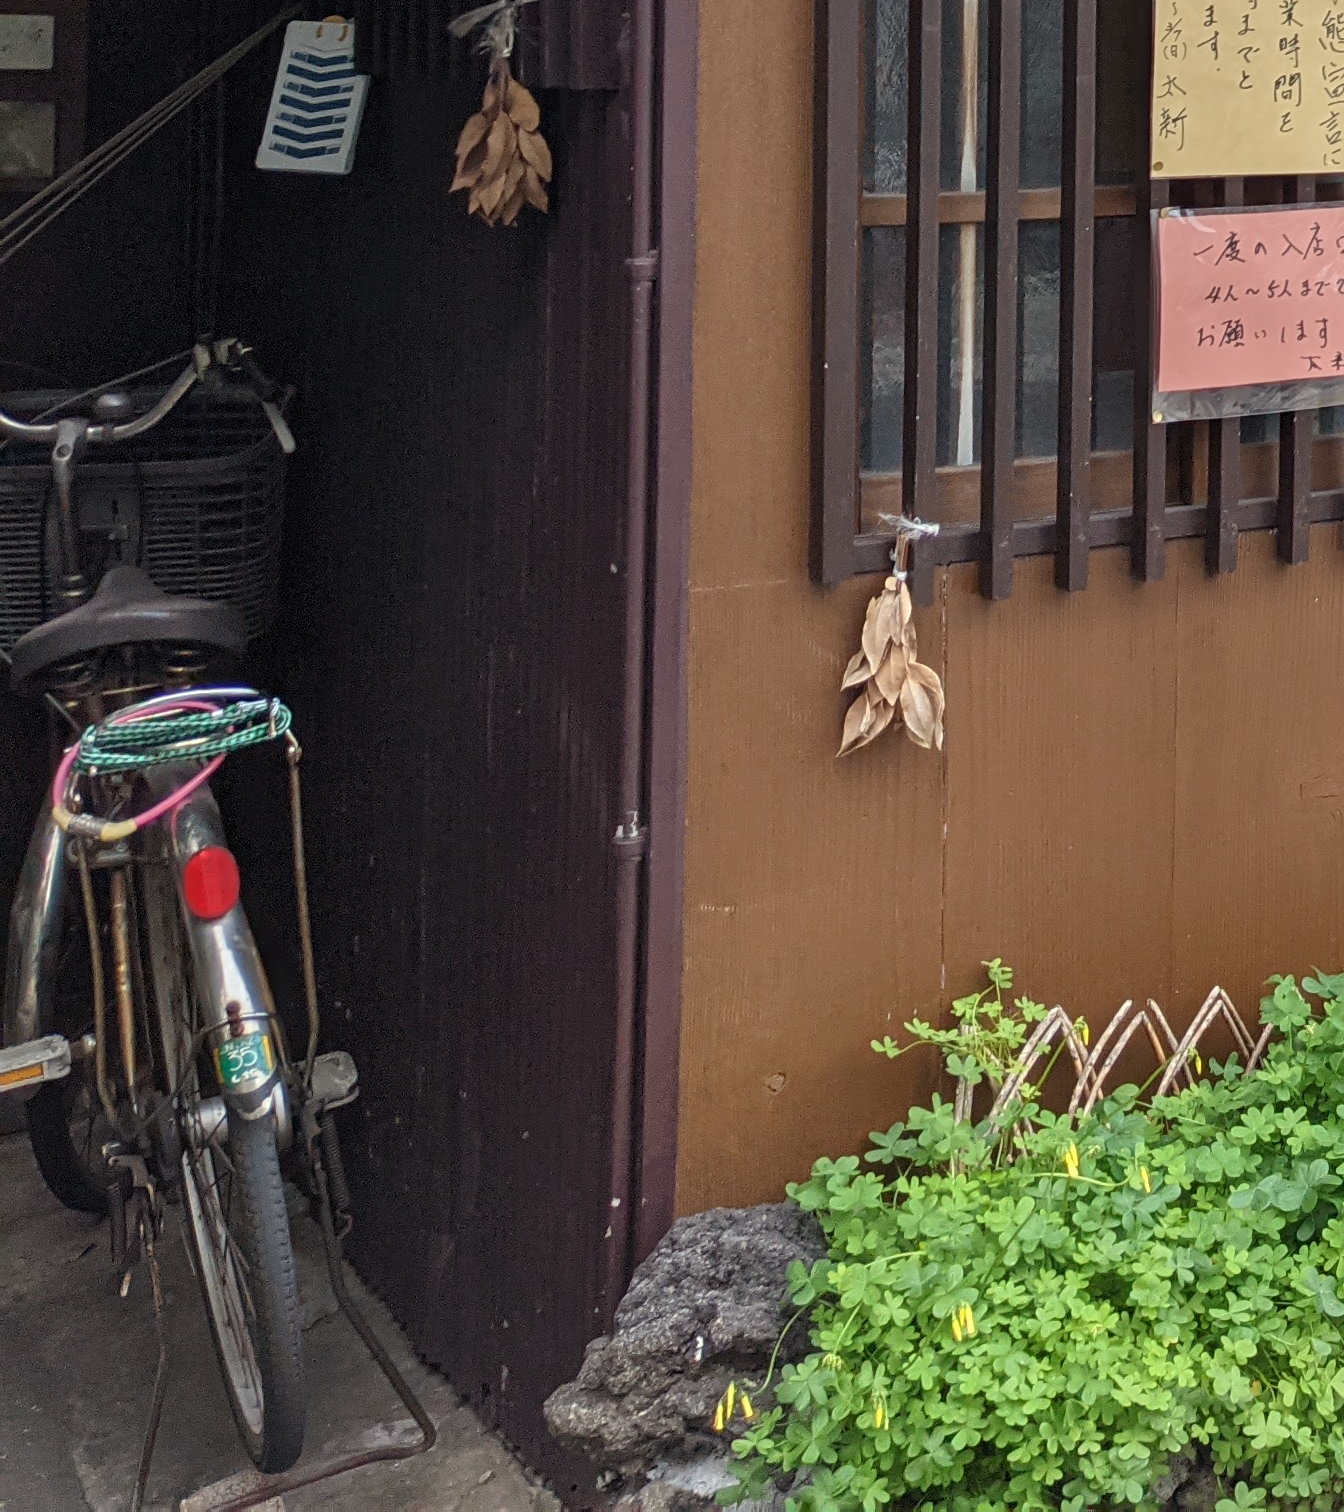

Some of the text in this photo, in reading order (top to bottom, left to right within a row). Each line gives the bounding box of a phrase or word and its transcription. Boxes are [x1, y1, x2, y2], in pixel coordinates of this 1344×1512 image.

[1197, 318, 1329, 348] お願いします
[227, 1045, 257, 1072] 35
